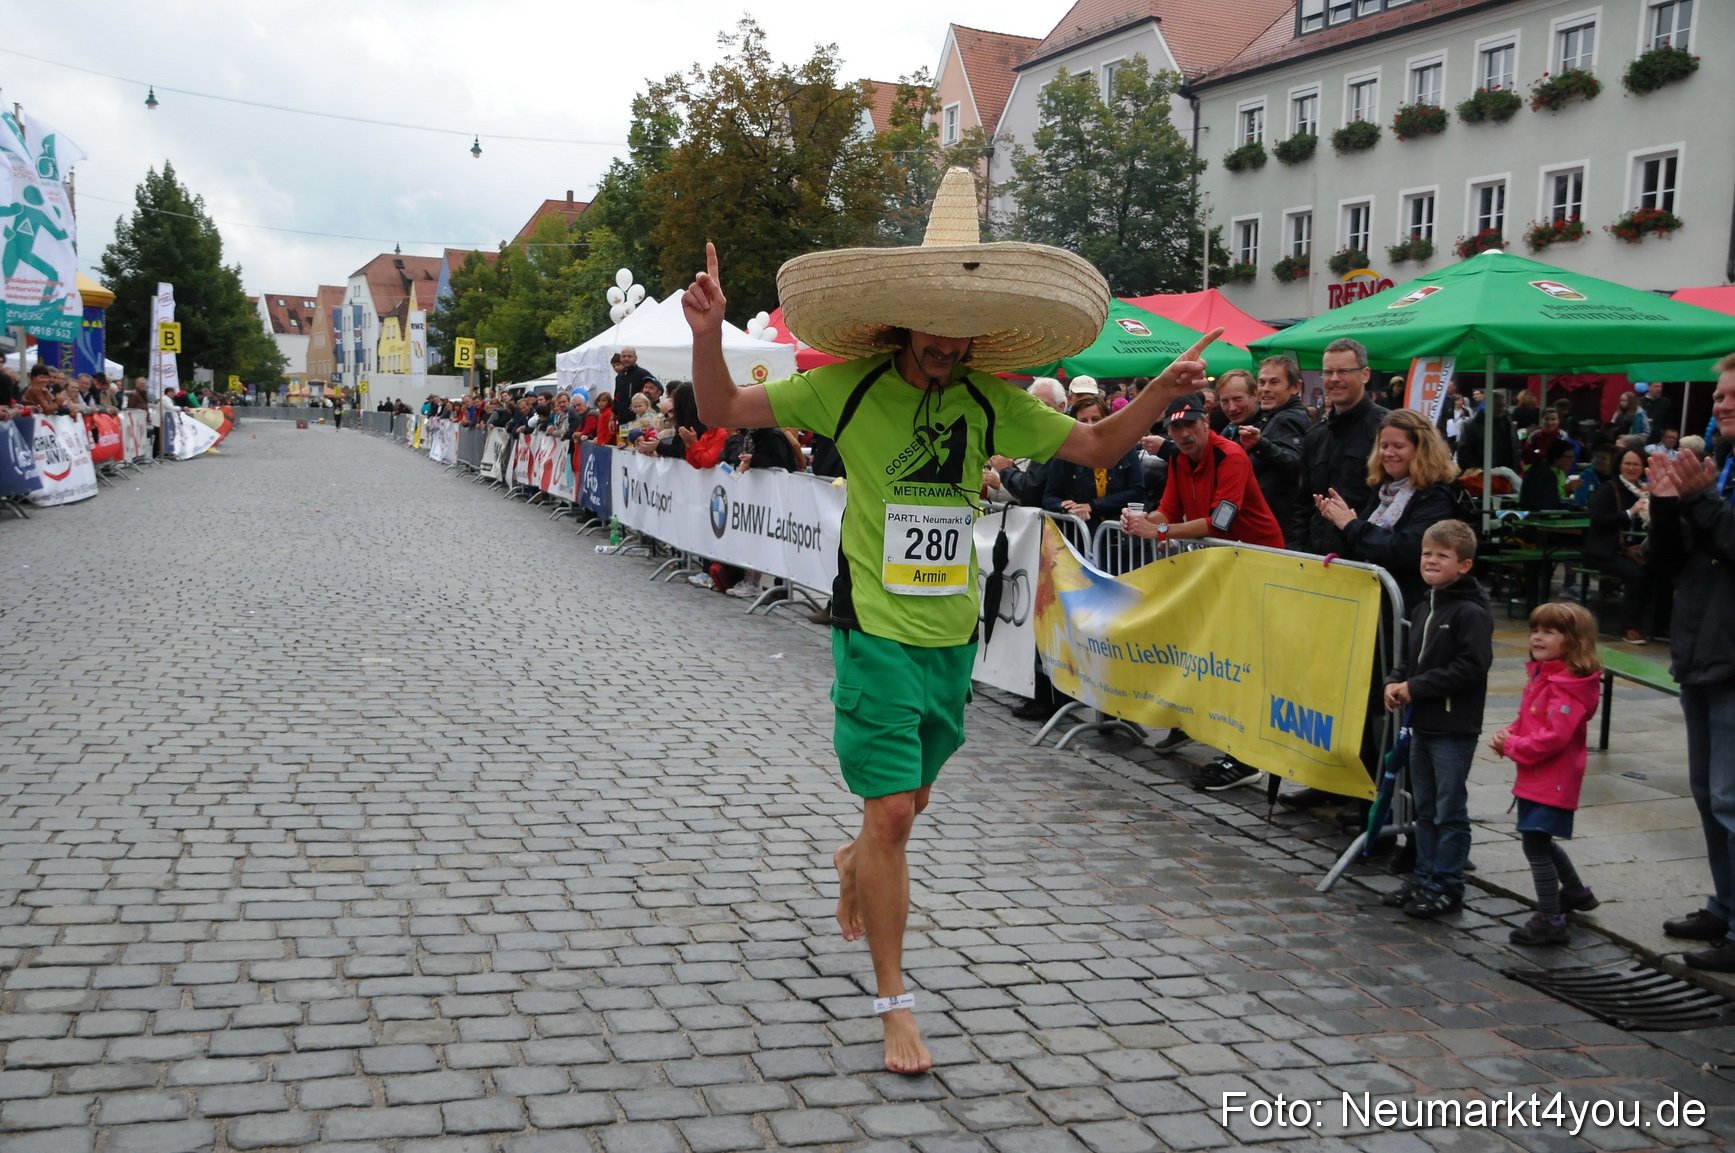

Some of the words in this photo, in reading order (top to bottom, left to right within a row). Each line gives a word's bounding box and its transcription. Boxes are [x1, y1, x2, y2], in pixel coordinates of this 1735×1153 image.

[164, 331, 176, 346] B
[458, 338, 473, 346] Block
[460, 346, 470, 361] B
[885, 436, 927, 476] GOSSEN
[887, 513, 920, 524] PARTL
[922, 515, 963, 525] Neumarkt
[732, 501, 766, 537] BMW
[767, 507, 822, 553] Laufsport
[904, 527, 959, 561] 280
[913, 569, 947, 583] Armin
[1270, 693, 1334, 752] KANN
